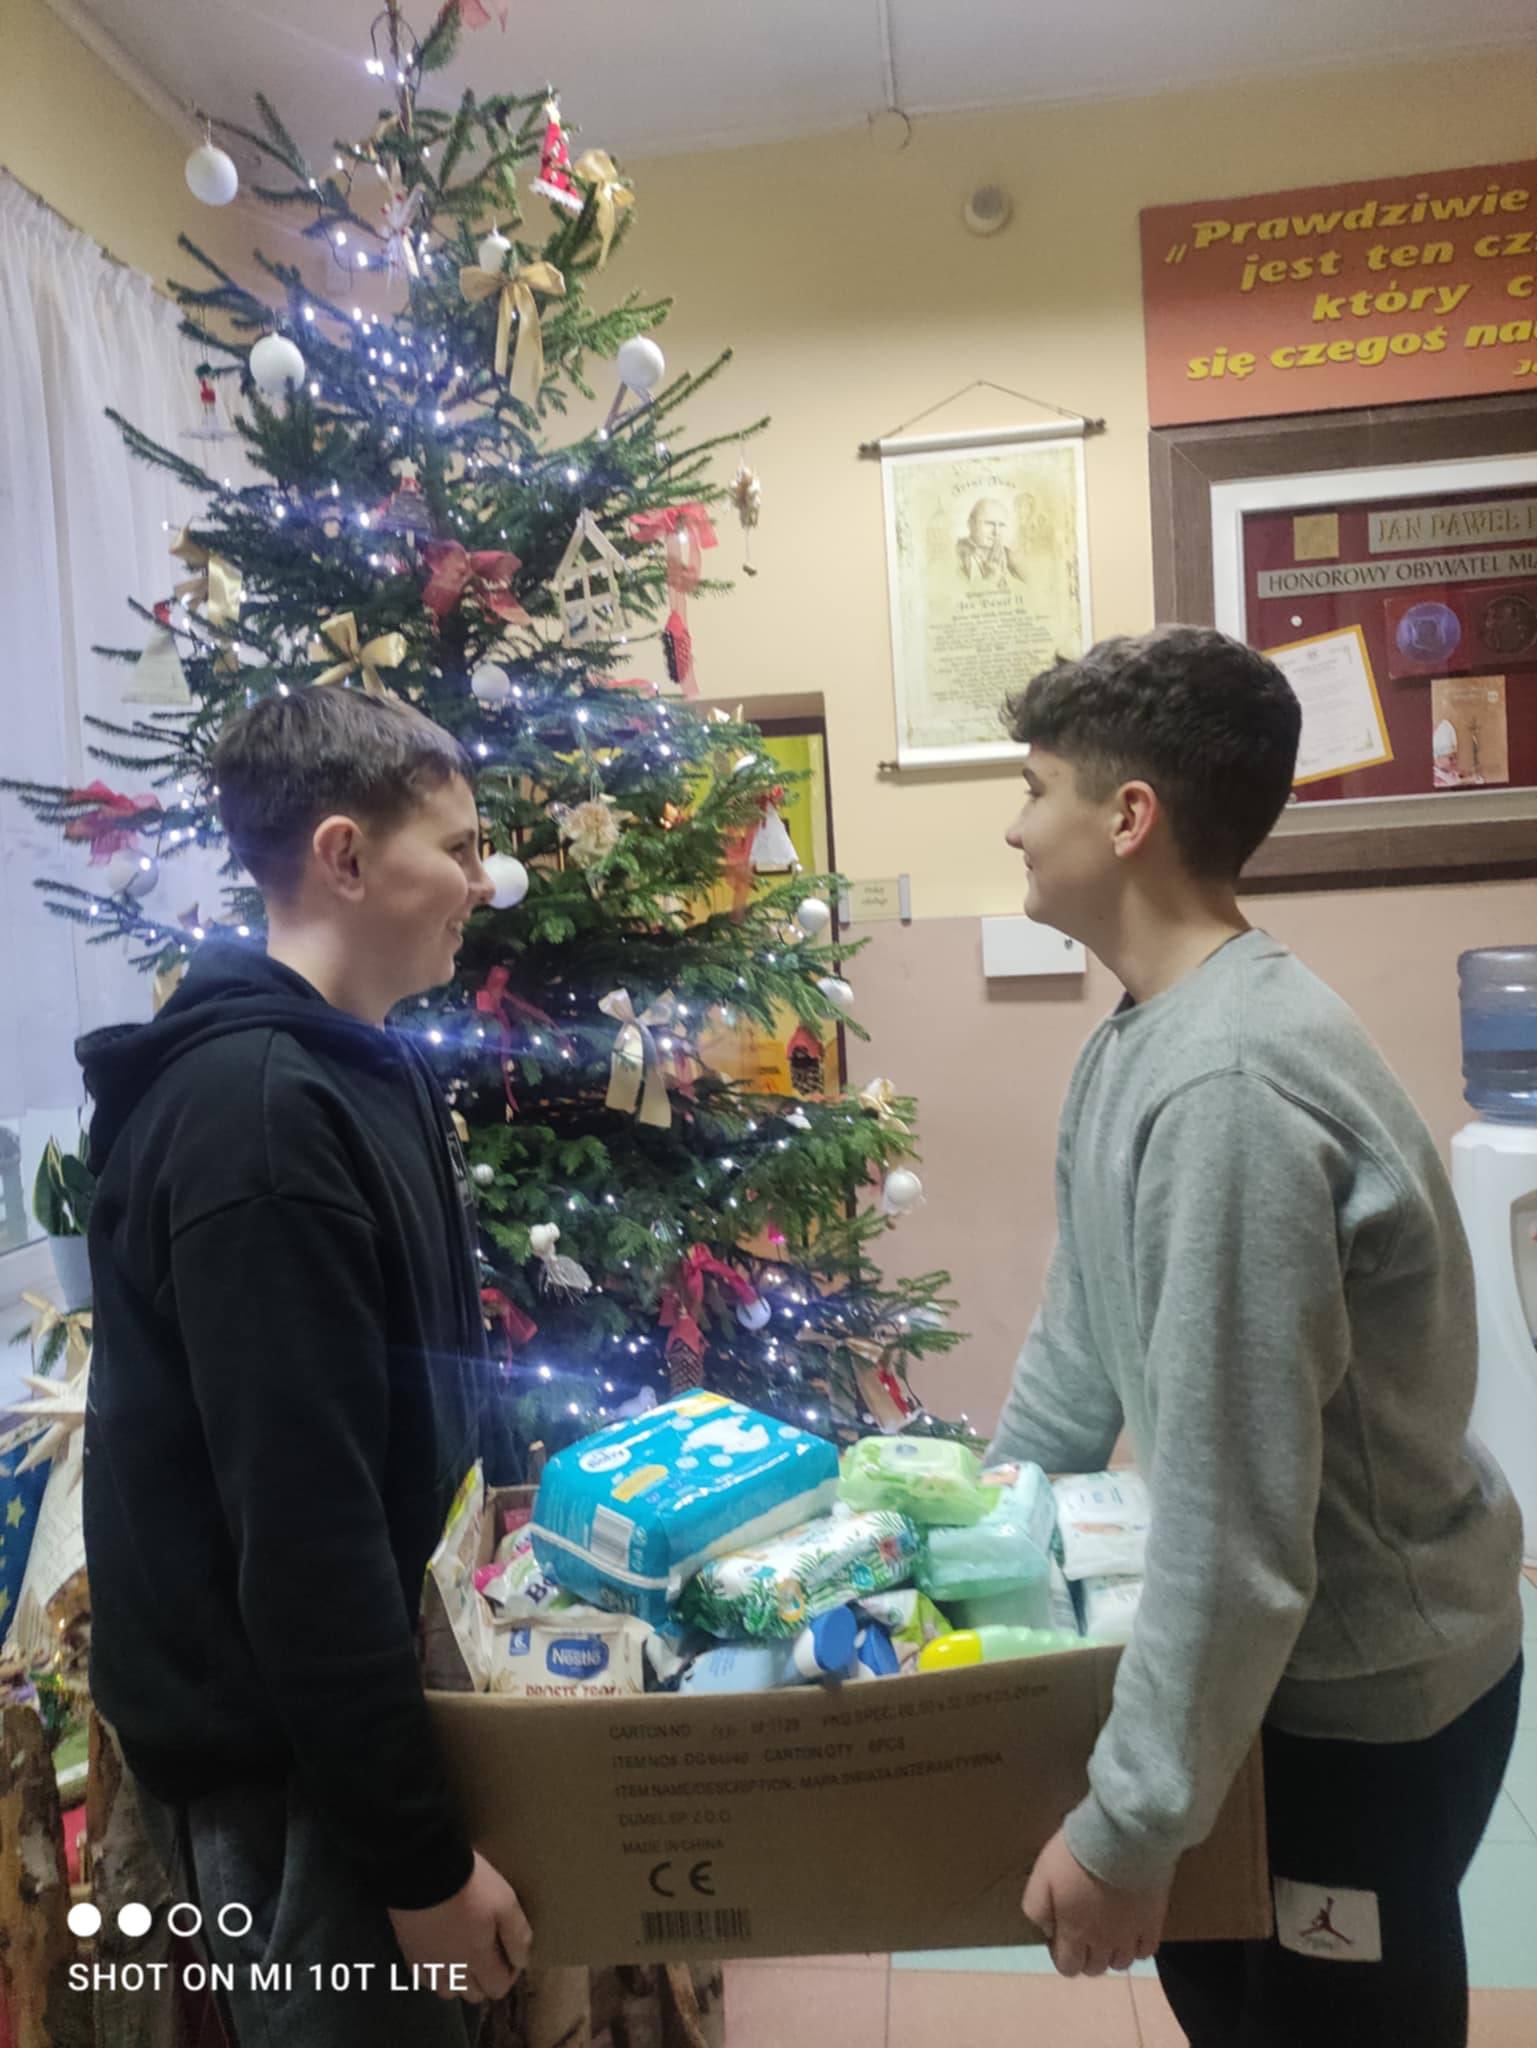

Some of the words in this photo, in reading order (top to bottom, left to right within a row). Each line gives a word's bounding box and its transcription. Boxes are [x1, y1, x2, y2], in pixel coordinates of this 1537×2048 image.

[1240, 250, 1342, 292] jest
[1366, 240, 1455, 271] ten
[1474, 231, 1537, 258] cz
[1312, 280, 1472, 322] który
[1187, 346, 1256, 380] się
[1270, 324, 1448, 369] czegoś
[1463, 319, 1537, 348] na
[1269, 565, 1390, 592] HONOROWY
[1395, 555, 1498, 580] OBYWATEL
